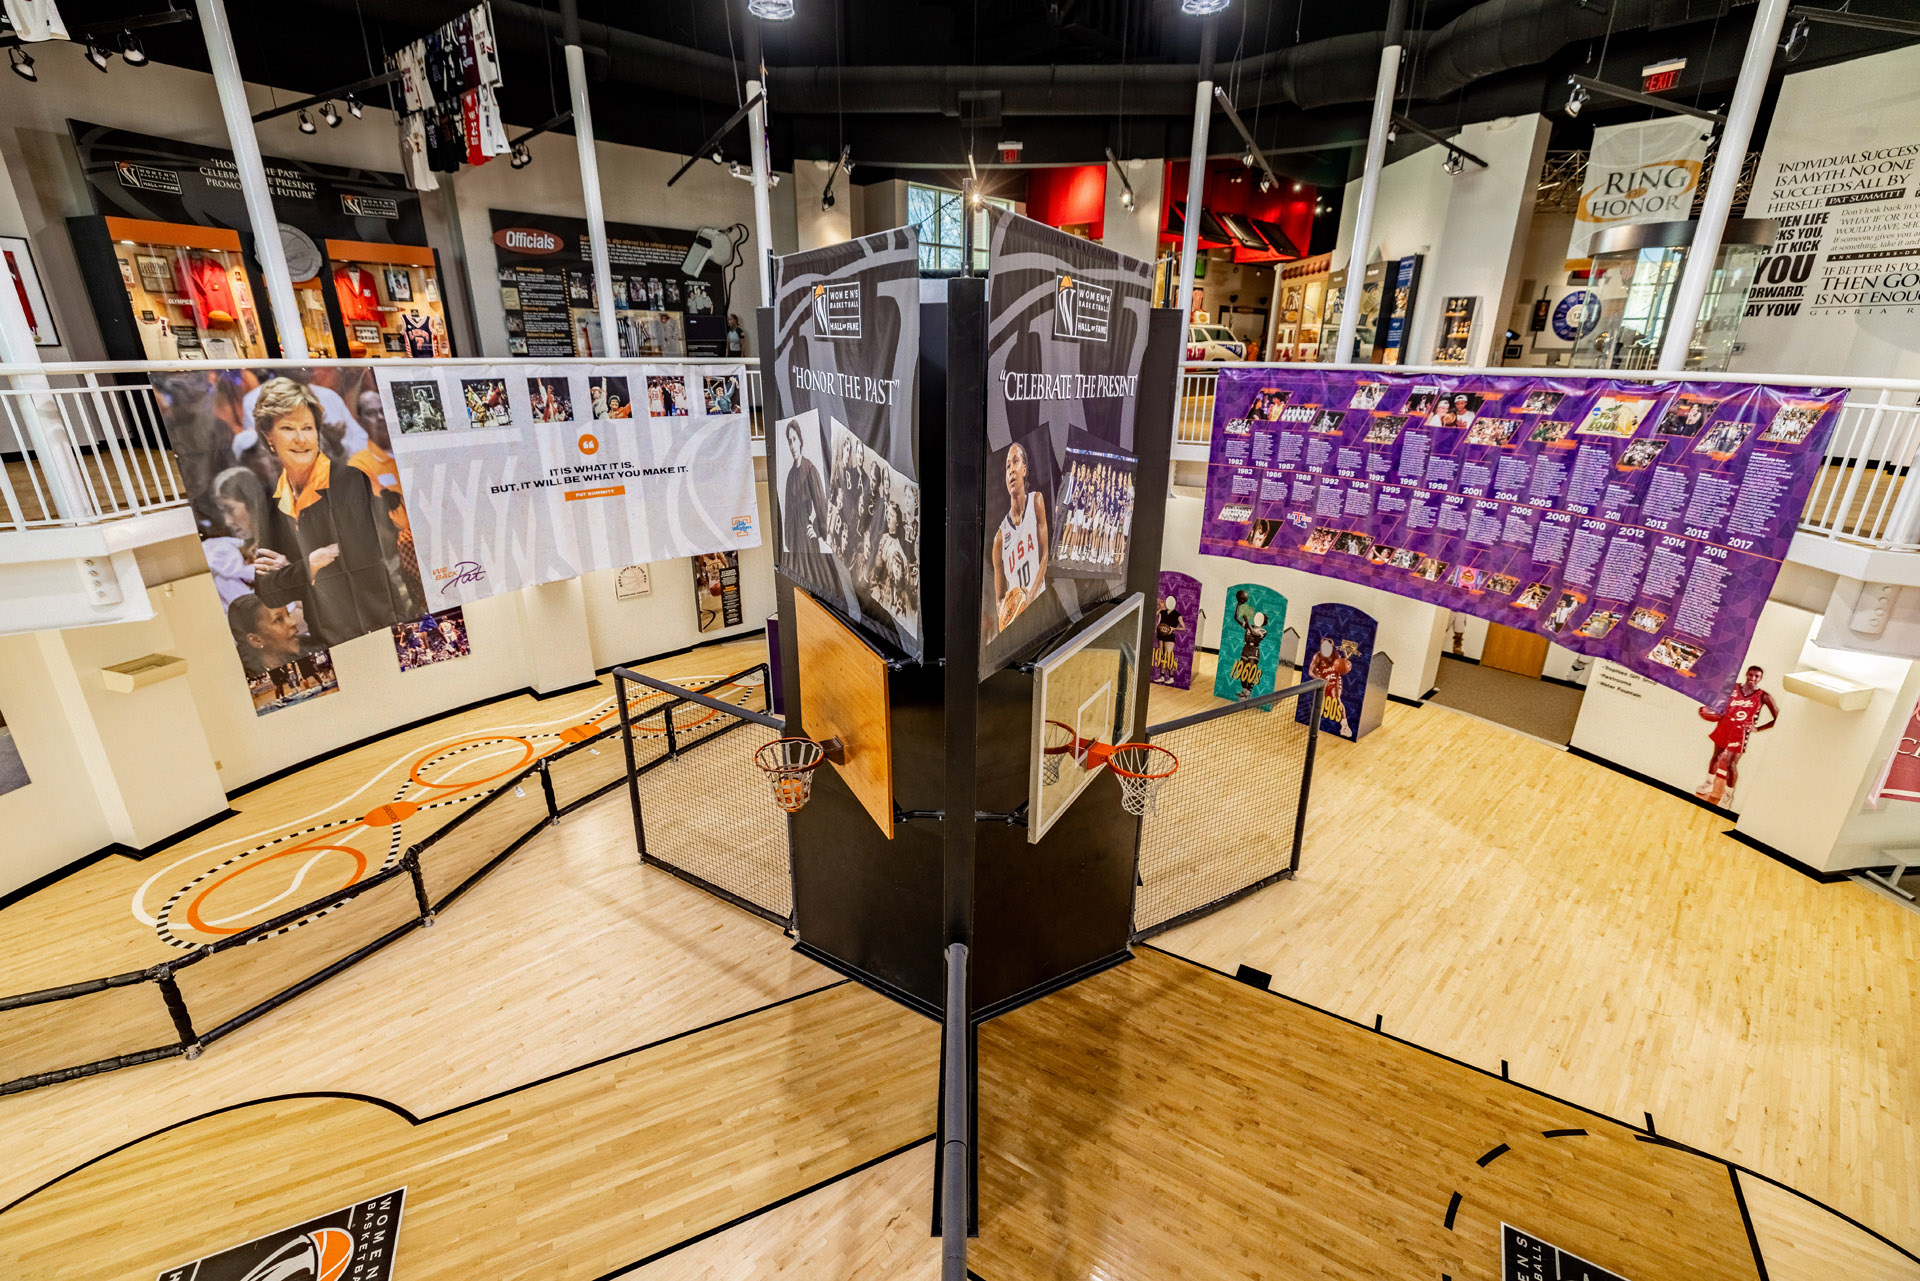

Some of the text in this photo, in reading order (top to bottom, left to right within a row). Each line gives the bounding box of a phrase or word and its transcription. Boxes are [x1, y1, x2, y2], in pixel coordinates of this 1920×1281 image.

[1650, 71, 1676, 90] EXIT
[1859, 144, 1919, 162] SUCCESS
[140, 168, 176, 179] WOMEN'S
[1605, 167, 1688, 195] RING
[1775, 159, 1915, 187] IS A MYTH. NO ONE
[206, 177, 242, 190] PROMO
[1771, 181, 1852, 200] SUCCEEDS
[1853, 177, 1884, 190] ALL
[1886, 173, 1911, 187] BY
[1591, 195, 1680, 217] HONOR
[1828, 190, 1902, 206] PAT SUMMITT
[1864, 206, 1881, 215] look
[1883, 203, 1901, 213] back
[1770, 212, 1830, 228] HEN LIFE
[1798, 226, 1823, 239] YOU,
[1836, 226, 1872, 235] WOULD
[1875, 233, 1895, 243] gives
[1896, 231, 1912, 241] you
[506, 231, 554, 249] Officials
[1775, 243, 1788, 254] IT
[1789, 240, 1821, 253] KICK
[1880, 240, 1895, 248] take
[1753, 254, 1817, 284] YOU
[1838, 265, 1883, 275] BETTER
[1885, 263, 1897, 272] IS
[1821, 273, 1920, 290] THEN GO
[830, 290, 858, 300] WOMEN'S
[1079, 289, 1110, 303] WOMEN'S
[1815, 290, 1920, 305] IS NOT ENOU
[830, 301, 858, 309] BASKETBALL
[1766, 303, 1801, 316] YOW
[1810, 308, 1887, 316] GLORIA
[847, 322, 859, 331] FAME
[1078, 322, 1090, 332] HALL
[1096, 325, 1107, 334] FAME
[793, 365, 899, 406] "HONOR THE PAST"
[1000, 370, 1096, 401] "CELEBRATE THE
[550, 461, 634, 477] IT IS WHAT IT IS.
[491, 465, 689, 494] BUT, IT WILL BE WHAT YOU MAKE IT.
[1237, 467, 1253, 475] 1982
[1296, 473, 1311, 481] 1988
[1322, 477, 1339, 485] 1992
[1352, 481, 1369, 489] 1994
[1382, 485, 1400, 494] 1995
[1413, 490, 1430, 499] 1998
[1445, 495, 1464, 504] 2001
[1475, 500, 1498, 510] 2002
[1510, 505, 1532, 516] 2005
[1545, 512, 1571, 523] 2006
[1582, 519, 1606, 530] 2010
[1618, 527, 1645, 538] 2012
[1661, 535, 1686, 549] 2014
[1702, 546, 1728, 559] 2016
[1338, 469, 1355, 477] 1993
[1369, 473, 1385, 482] 1995
[1400, 478, 1418, 486] 1996
[1428, 482, 1448, 491] 1998
[1462, 487, 1482, 496] 2001
[1495, 491, 1518, 502] 2004
[1529, 497, 1552, 508] 2005
[1645, 518, 1669, 530] 2013
[1684, 527, 1710, 539] 2015
[1728, 537, 1753, 549] 2017
[1008, 532, 1035, 575] USA
[432, 566, 448, 576] WE
[441, 561, 487, 594] Pat
[1016, 560, 1032, 589] 10
[1151, 647, 1178, 672] 1940s
[1230, 660, 1263, 685] 1960s
[366, 1196, 393, 1280] WOMEN
